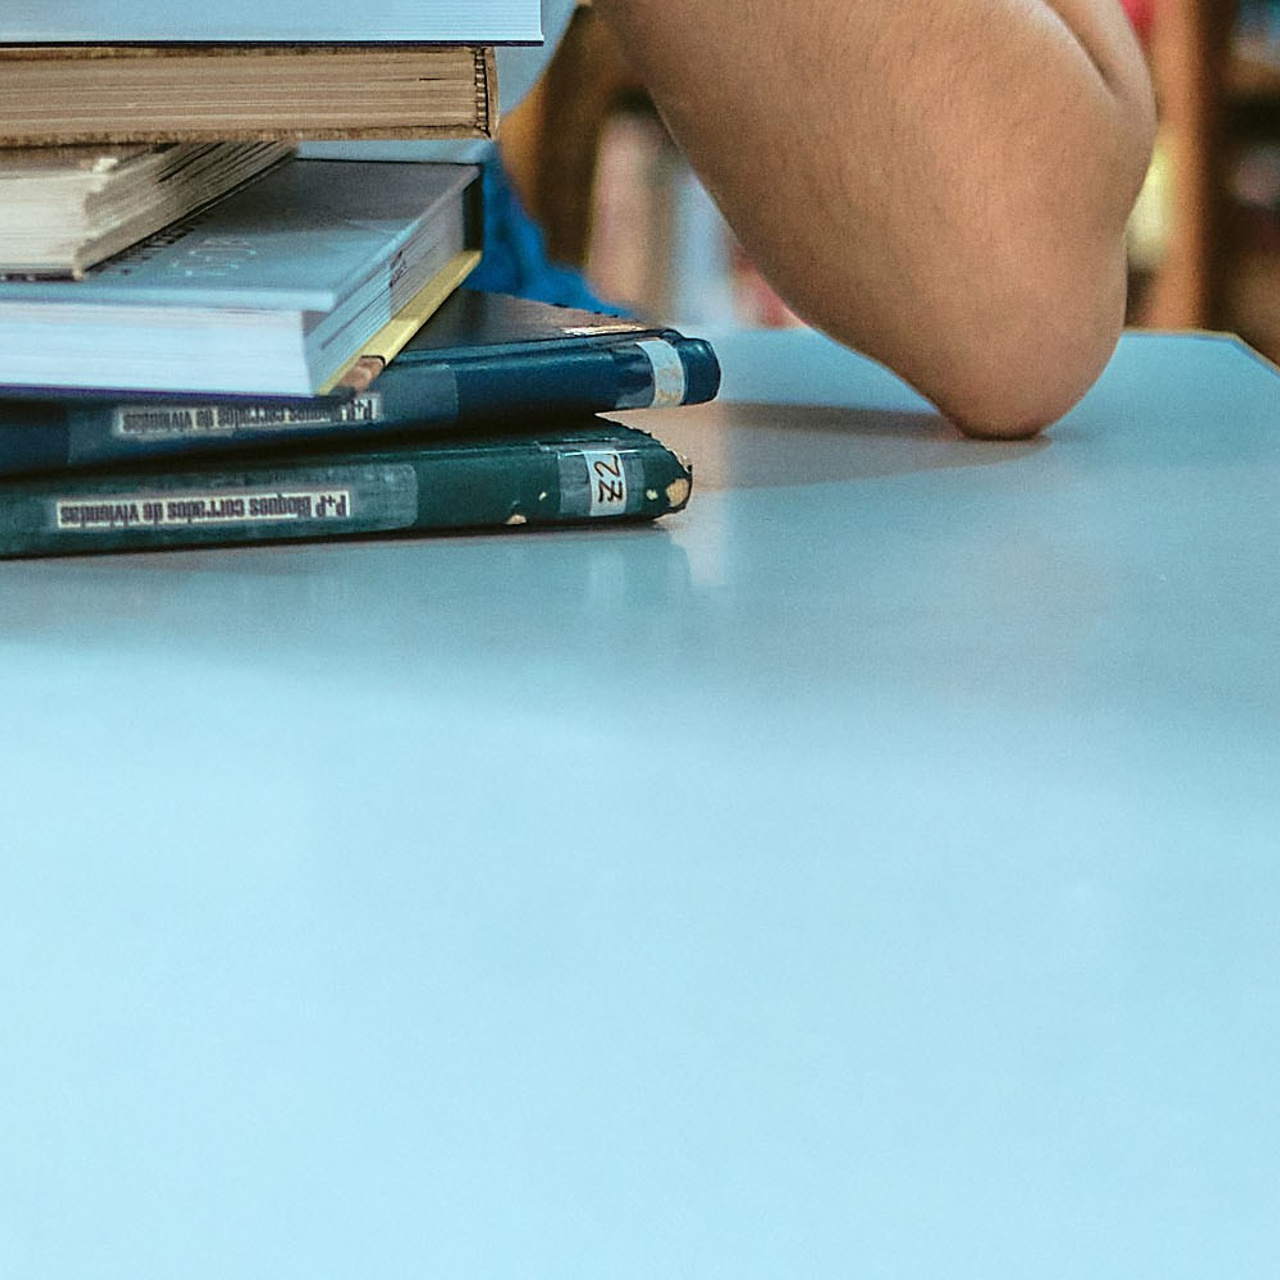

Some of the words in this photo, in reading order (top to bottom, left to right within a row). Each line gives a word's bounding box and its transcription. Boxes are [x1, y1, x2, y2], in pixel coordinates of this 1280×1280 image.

[196, 410, 213, 429] de
[60, 504, 140, 529] viviendas
[143, 503, 164, 526] de
[249, 494, 311, 519] Bloques
[315, 494, 347, 518] P+P
